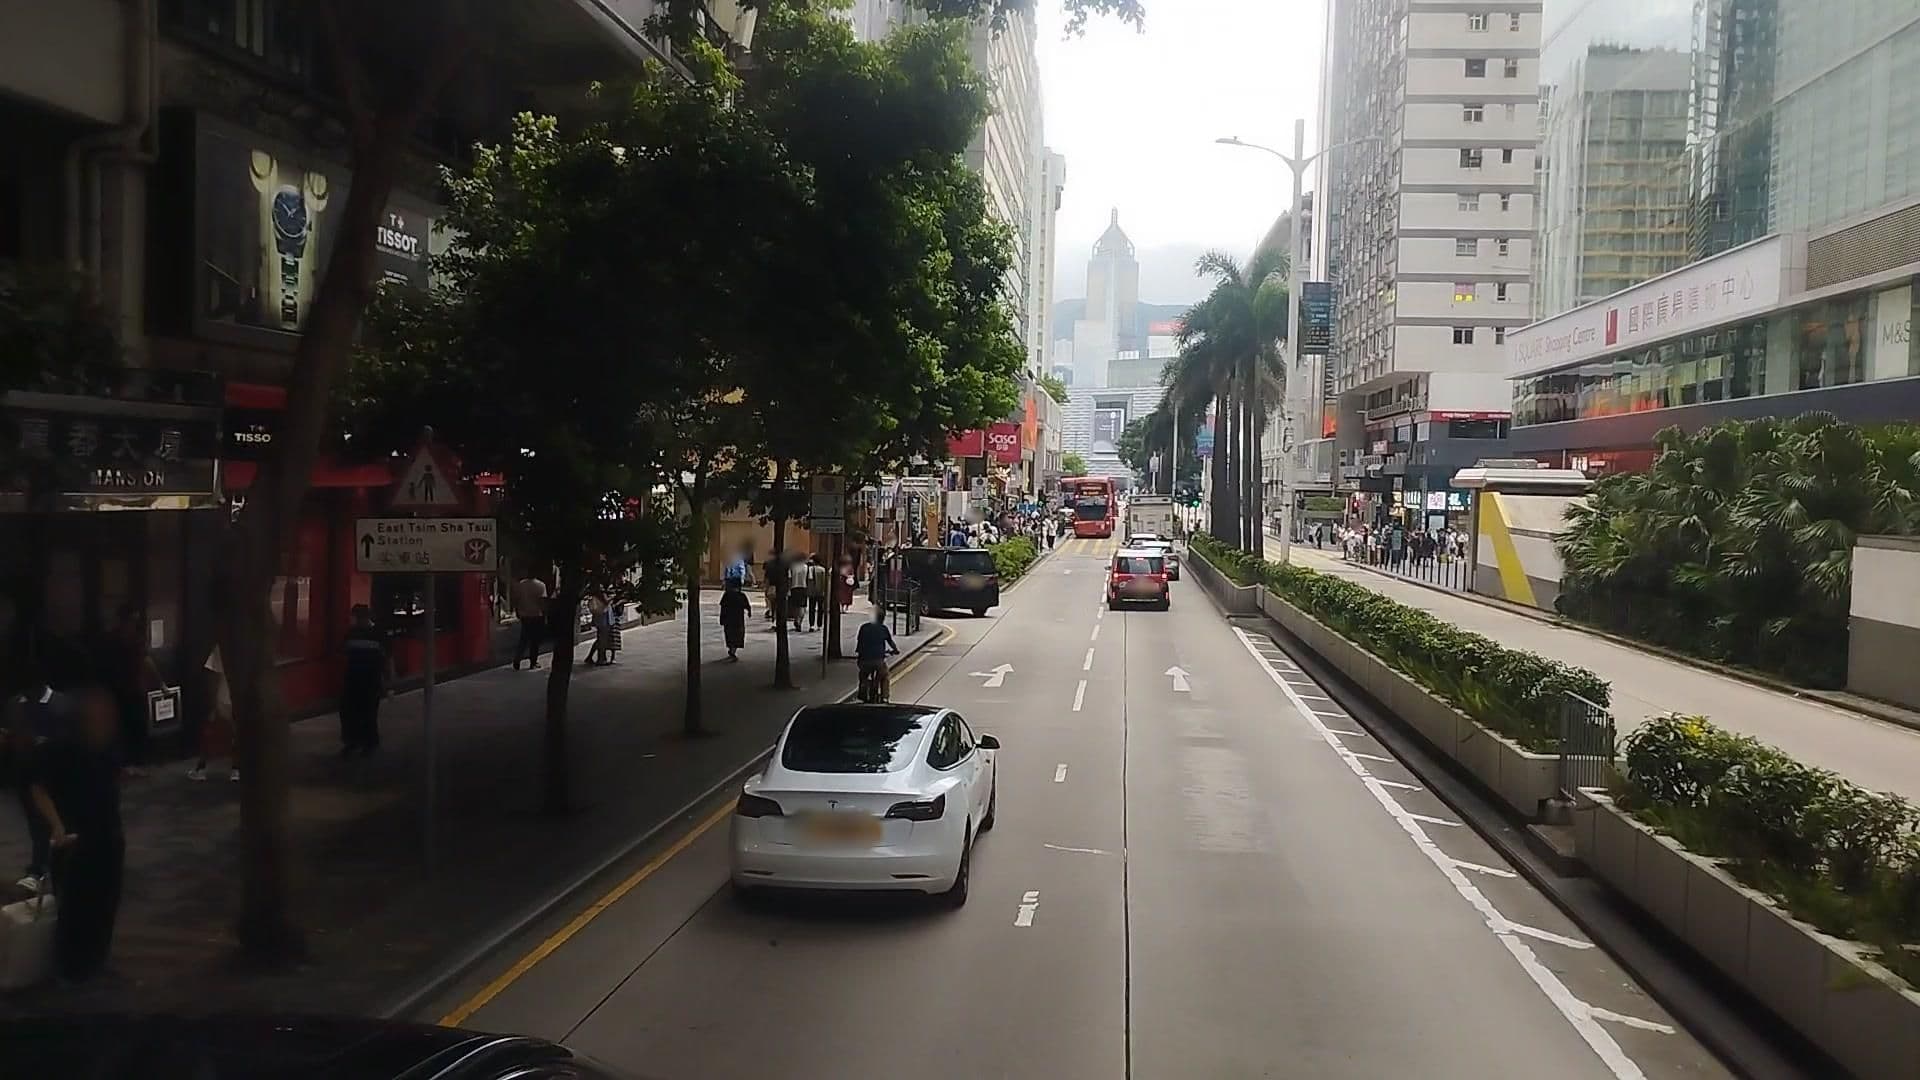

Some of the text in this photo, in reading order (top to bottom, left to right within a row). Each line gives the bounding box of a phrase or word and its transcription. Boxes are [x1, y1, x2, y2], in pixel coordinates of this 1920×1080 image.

[377, 226, 418, 253] TISSOT
[1882, 320, 1911, 344] M&S
[90, 468, 165, 486] MANSON
[377, 522, 493, 533] East Tsim Sha Tsui
[377, 535, 423, 546] Station
